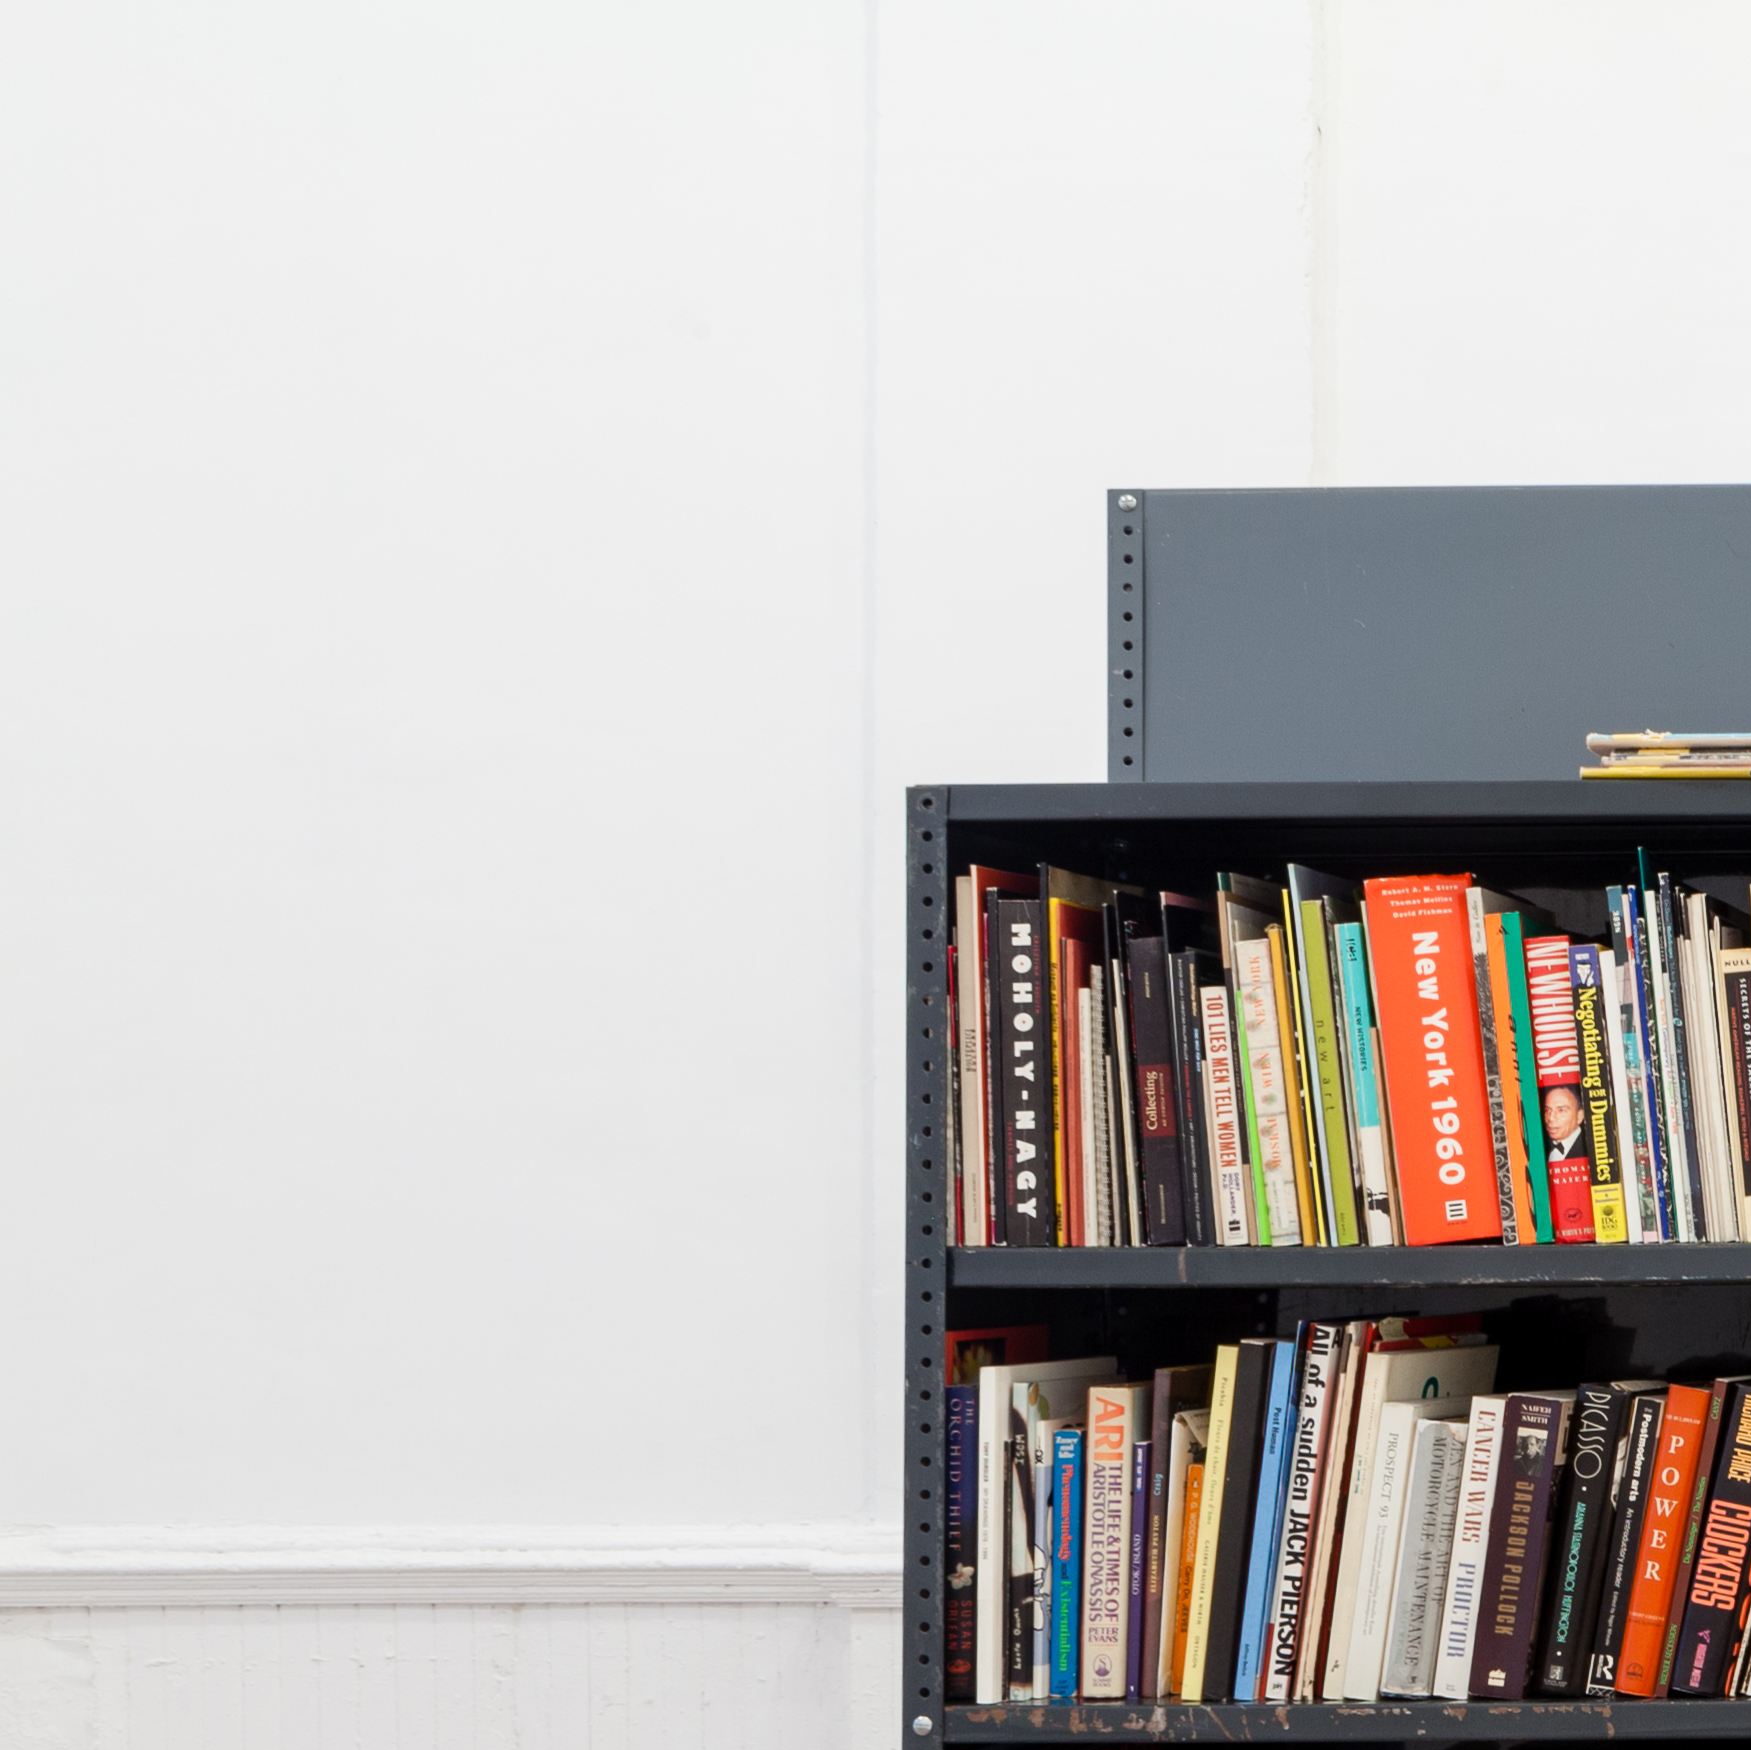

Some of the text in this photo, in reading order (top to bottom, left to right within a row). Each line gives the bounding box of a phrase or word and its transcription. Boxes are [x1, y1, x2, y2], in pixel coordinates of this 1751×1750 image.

[1011, 922, 1036, 1218] MOHOLY-NAGY
[1206, 995, 1238, 1168] 101 LIES MEN TELL WOMEN
[1413, 931, 1466, 1185] New York 1960
[1526, 941, 1580, 1080] NEWHOUSE
[1576, 986, 1613, 1182] Negotiating FOR Dummies
[1094, 1396, 1124, 1461] ARI
[1274, 1325, 1330, 1676] All of a sudden JACK PIERSON
[1573, 1392, 1612, 1479] PICASSO
[1446, 1410, 1496, 1658] CANCER WARS PROCTOR
